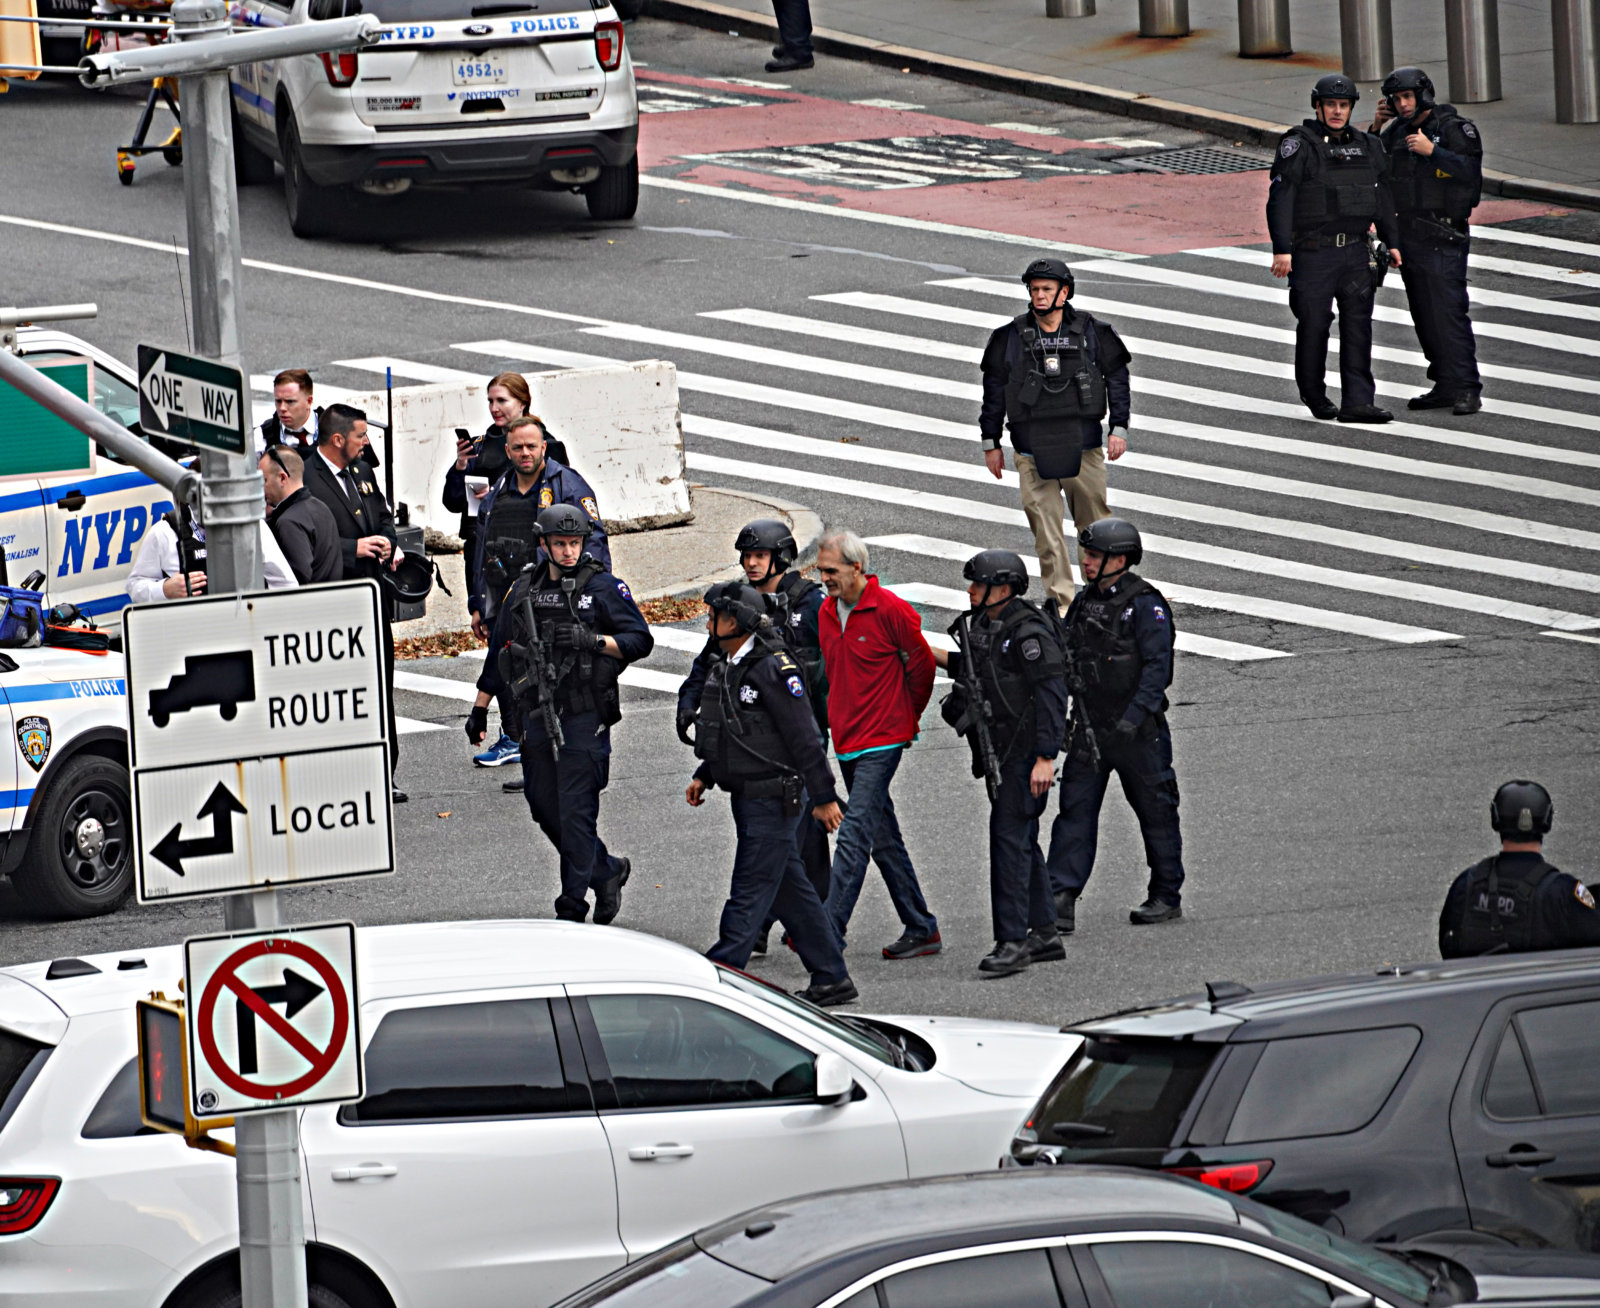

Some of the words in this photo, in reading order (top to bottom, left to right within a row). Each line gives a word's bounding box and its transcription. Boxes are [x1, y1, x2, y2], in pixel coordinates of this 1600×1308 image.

[380, 25, 435, 41] NYPD
[510, 16, 580, 34] POLICE
[458, 63, 492, 78] 4952
[458, 89, 521, 100] @NYPD17PCT
[1033, 336, 1070, 349] POLICE
[149, 373, 184, 413] ONE
[201, 385, 234, 425] WAY
[0, 534, 16, 546] ESY
[4, 546, 40, 562] ONALISM
[264, 625, 365, 667] TRUCK
[72, 679, 119, 698] POLICE
[268, 687, 369, 729] ROUTE
[18, 724, 49, 735] DEPARTMENT
[270, 791, 375, 836] Local
[1479, 892, 1515, 913] NPD
